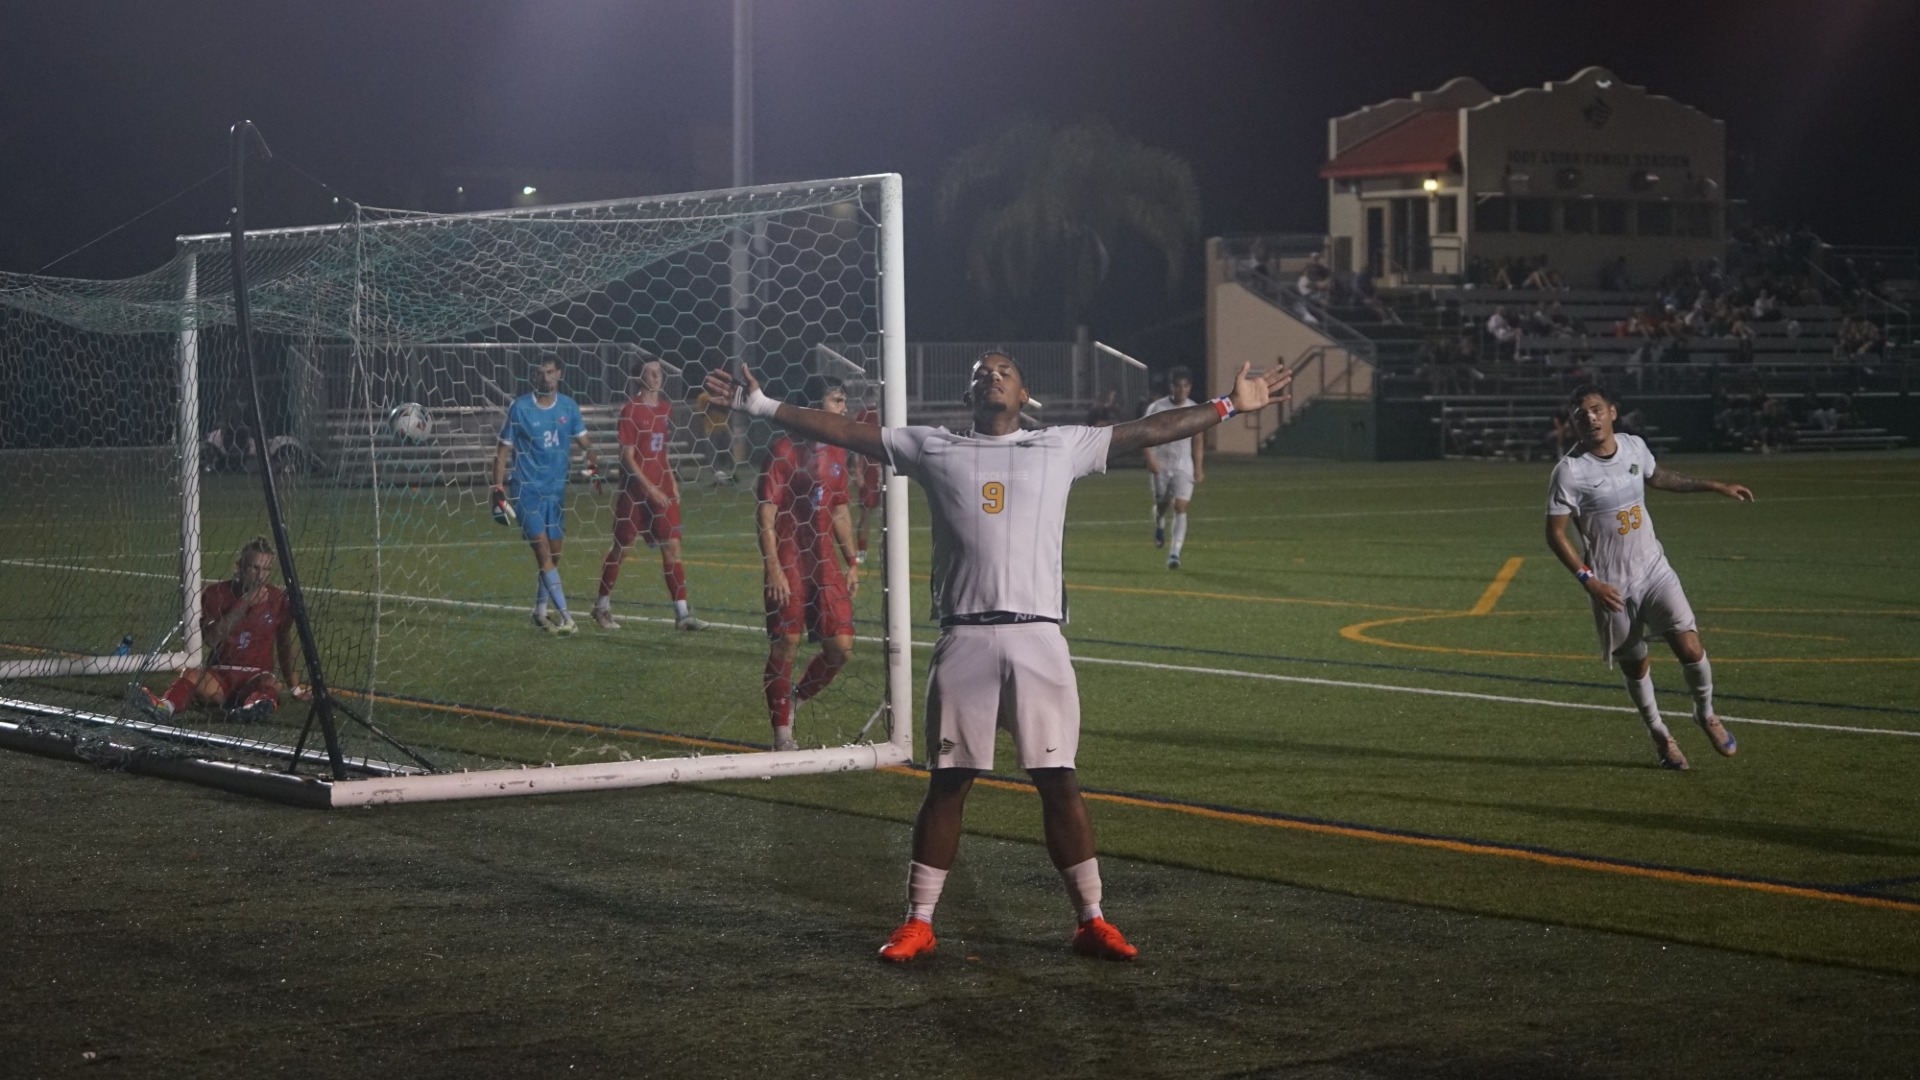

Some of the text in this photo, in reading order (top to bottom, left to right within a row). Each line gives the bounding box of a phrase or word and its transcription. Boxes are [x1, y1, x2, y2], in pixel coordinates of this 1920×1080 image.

[543, 429, 560, 448] 24
[982, 481, 1005, 514] 9
[1616, 505, 1643, 535] 33
